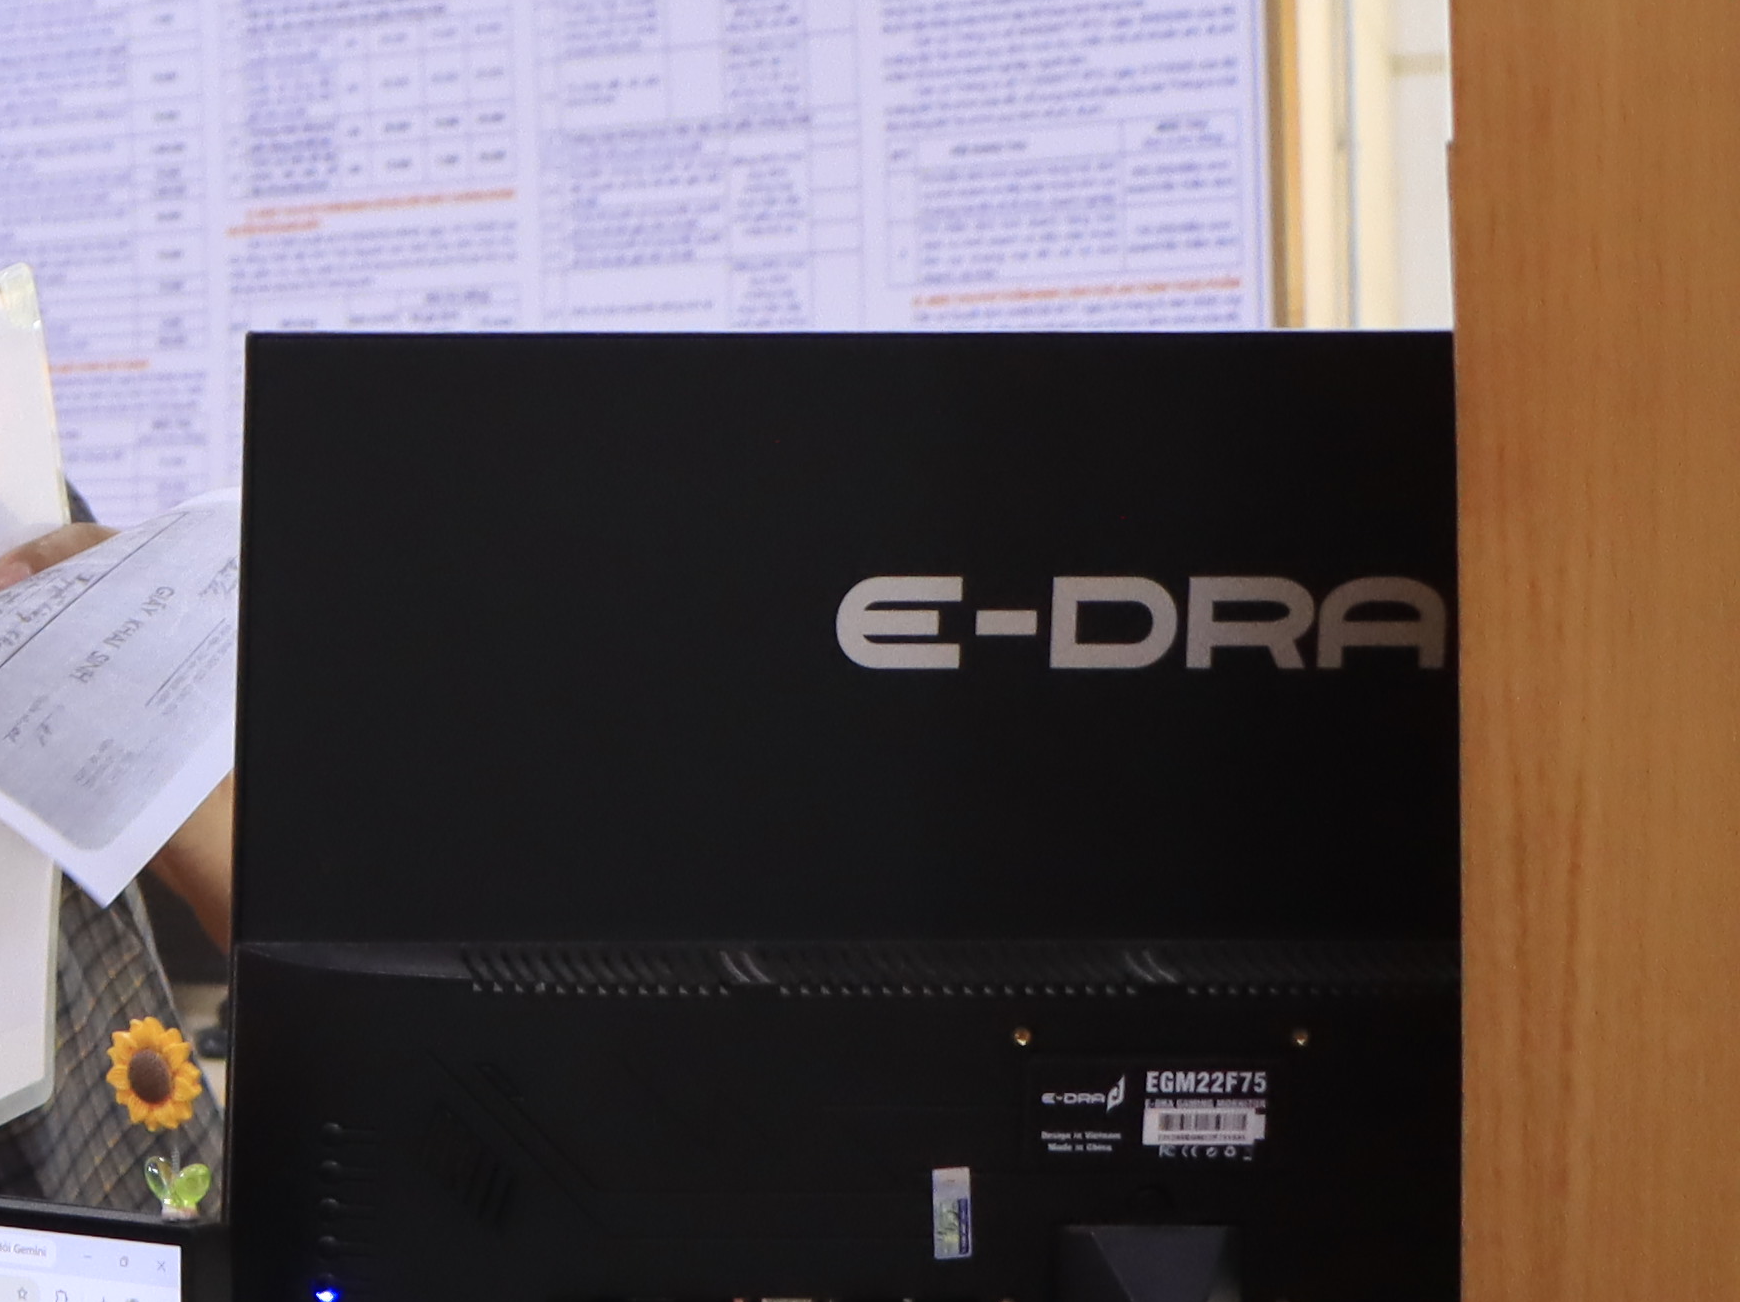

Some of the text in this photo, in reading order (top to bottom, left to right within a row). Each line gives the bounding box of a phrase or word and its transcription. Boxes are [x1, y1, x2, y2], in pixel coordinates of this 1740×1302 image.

[836, 576, 1446, 669] E-DRA
[1146, 1070, 1267, 1094] EGM22F75
[14, 1243, 46, 1256] Gemini
